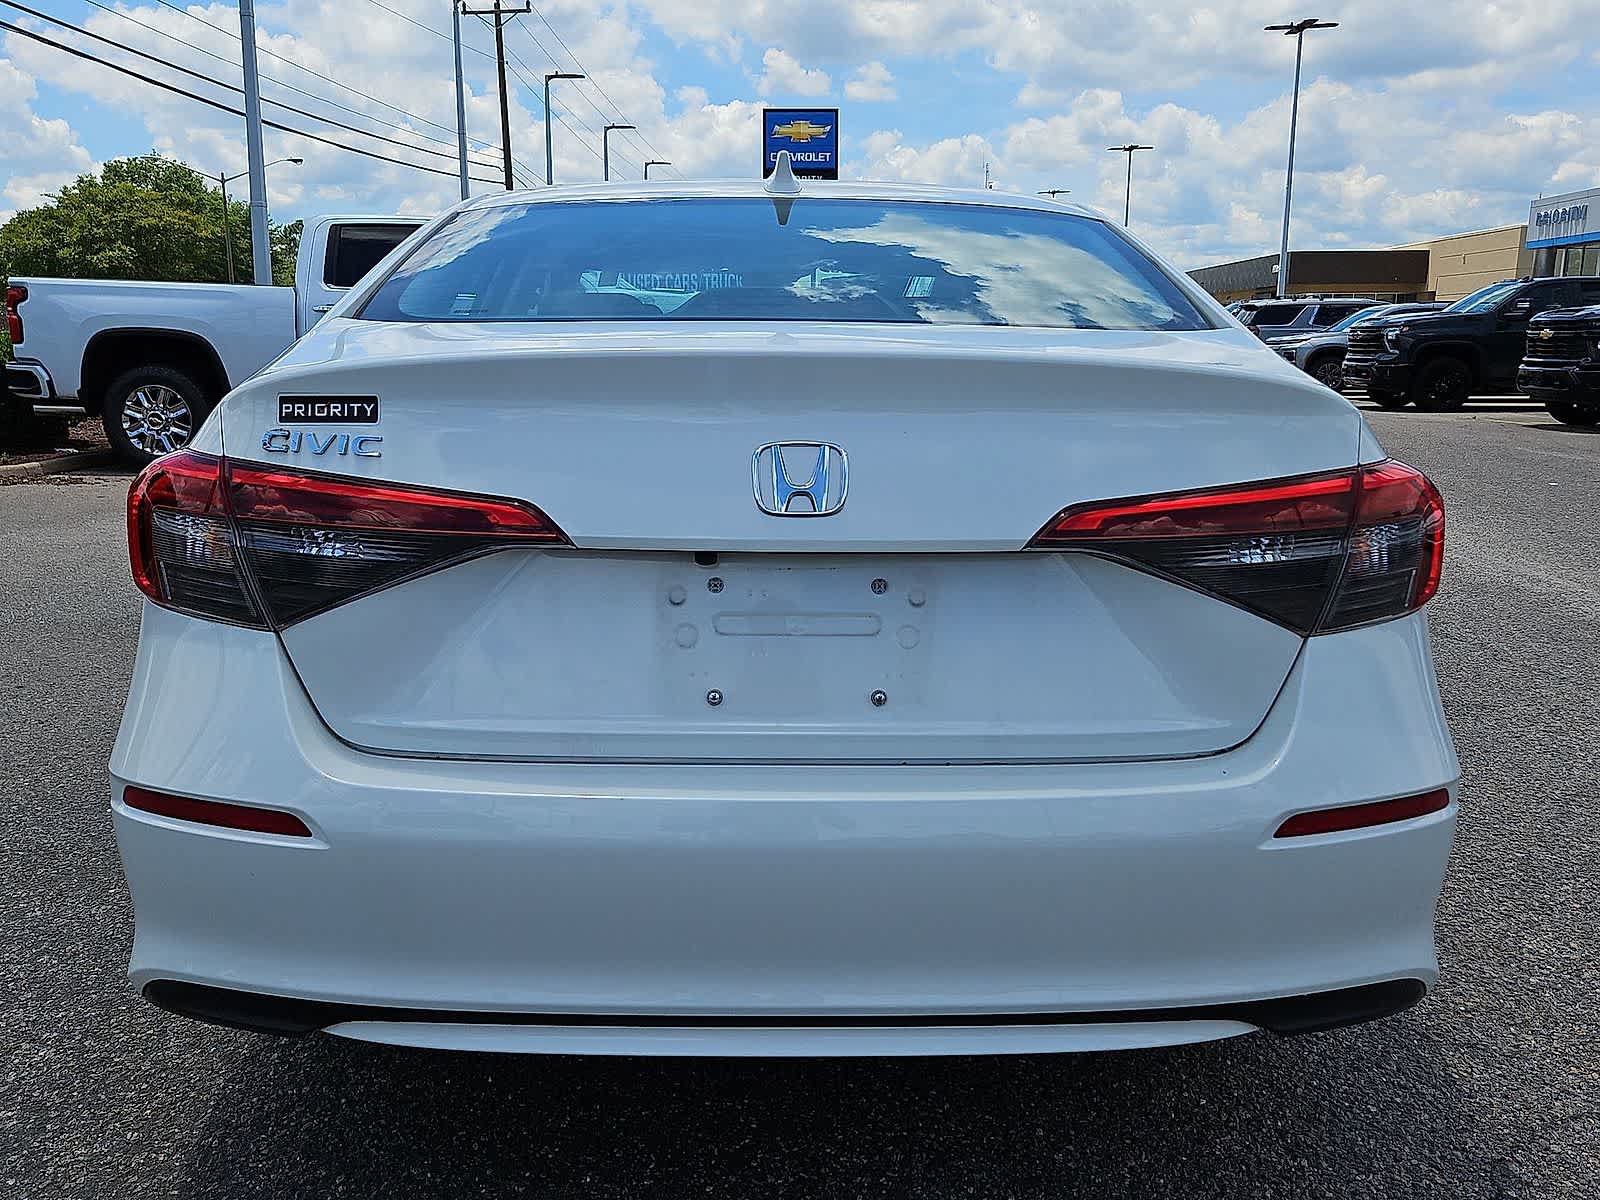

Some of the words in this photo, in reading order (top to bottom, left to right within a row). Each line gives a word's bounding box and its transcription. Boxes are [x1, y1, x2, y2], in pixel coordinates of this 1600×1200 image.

[770, 152, 831, 162] CVROLET
[282, 403, 375, 416] PRIORITY
[262, 429, 383, 457] CIVIC
